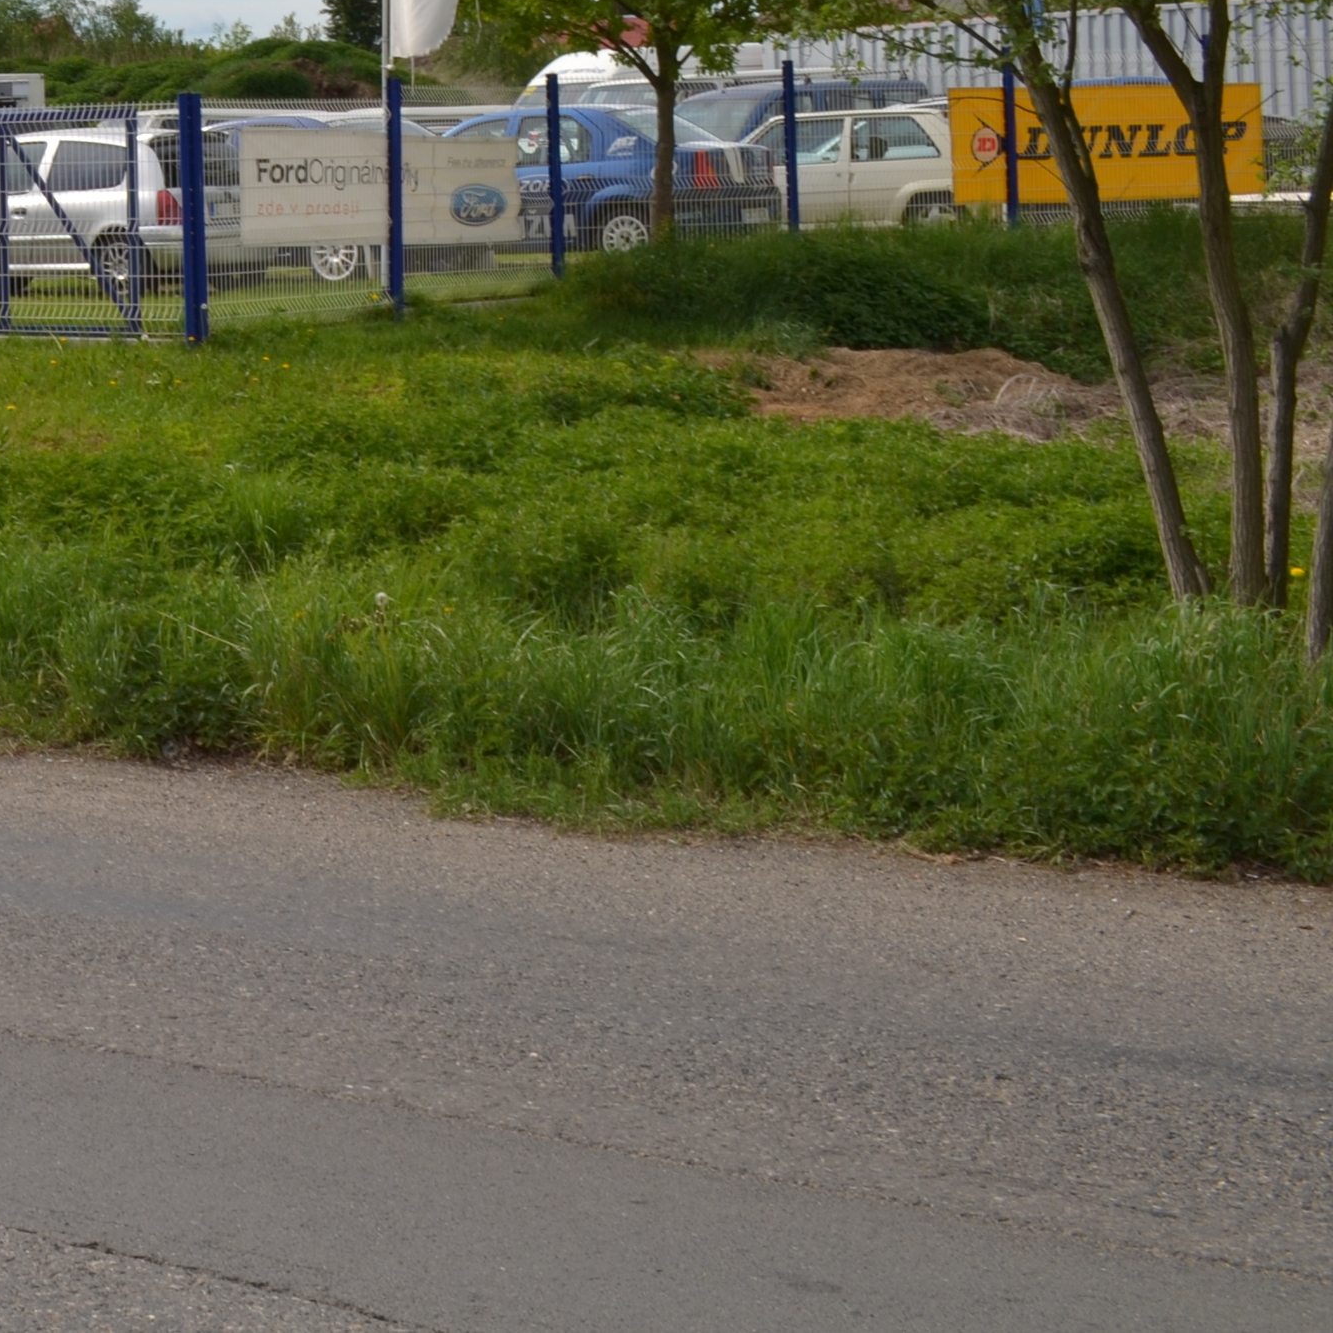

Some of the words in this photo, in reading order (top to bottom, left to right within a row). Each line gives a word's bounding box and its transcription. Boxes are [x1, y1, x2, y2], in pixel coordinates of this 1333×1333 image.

[257, 201, 284, 216] zde
[290, 204, 298, 214] v
[459, 190, 498, 218] Ford
